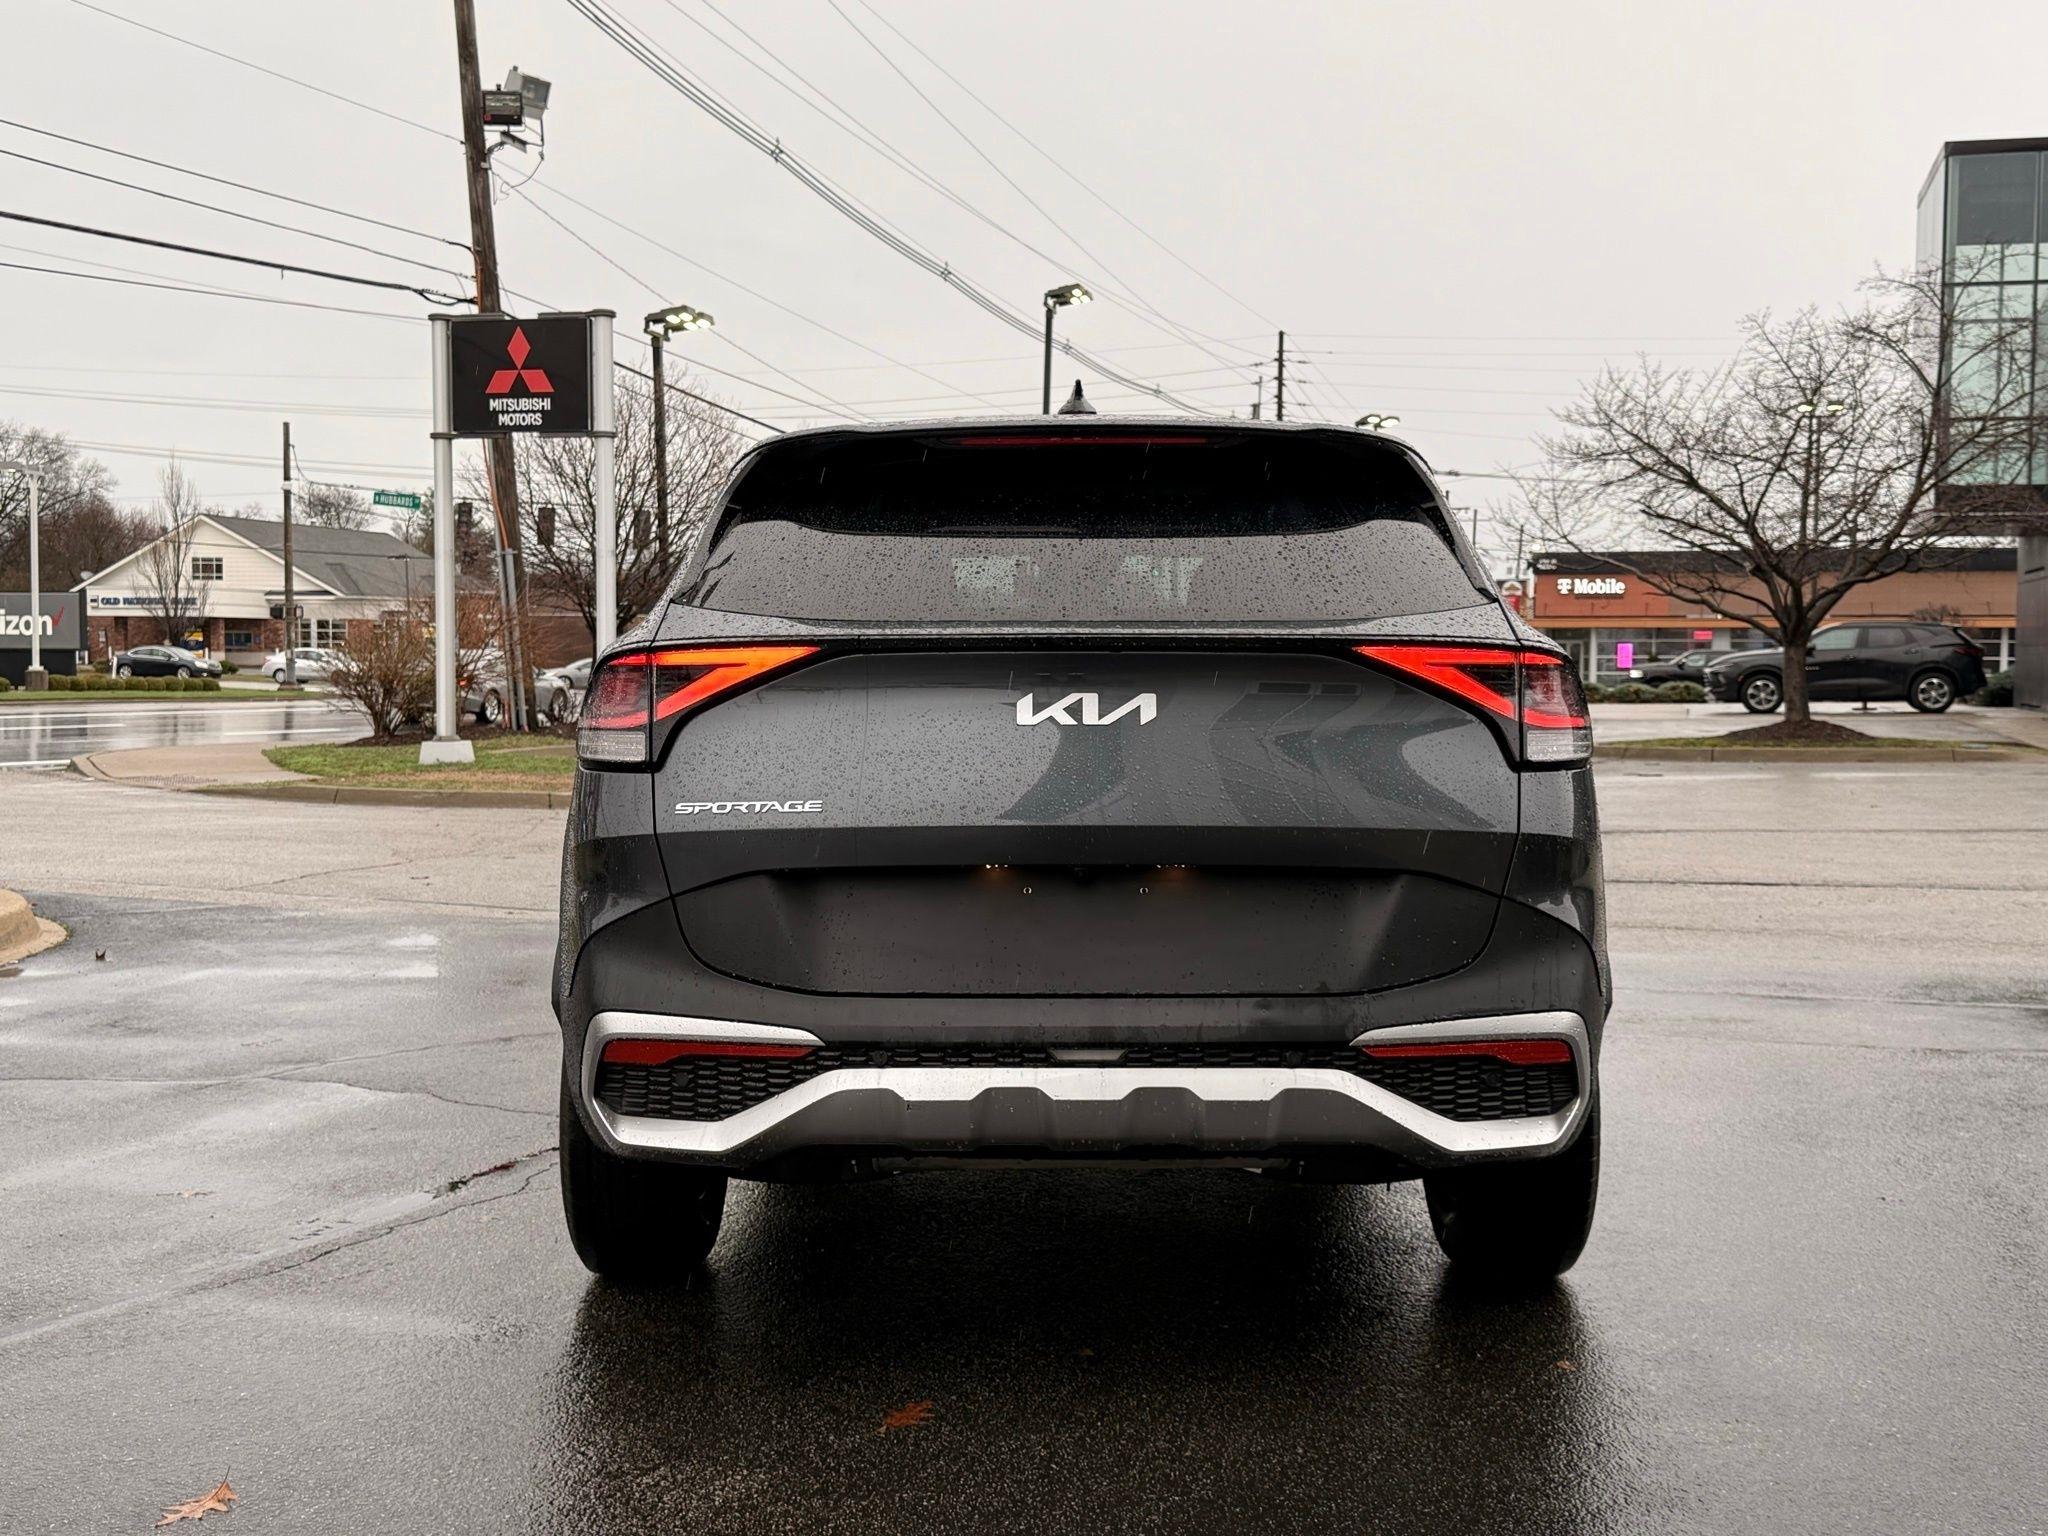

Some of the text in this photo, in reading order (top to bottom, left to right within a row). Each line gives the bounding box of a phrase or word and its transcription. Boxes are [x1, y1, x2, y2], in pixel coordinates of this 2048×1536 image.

[489, 397, 551, 411] MITSUBISHI
[498, 412, 543, 426] MOTORS
[100, 597, 120, 605] OLD
[1016, 692, 1157, 726] KIA
[674, 800, 824, 815] SPORTAGE
